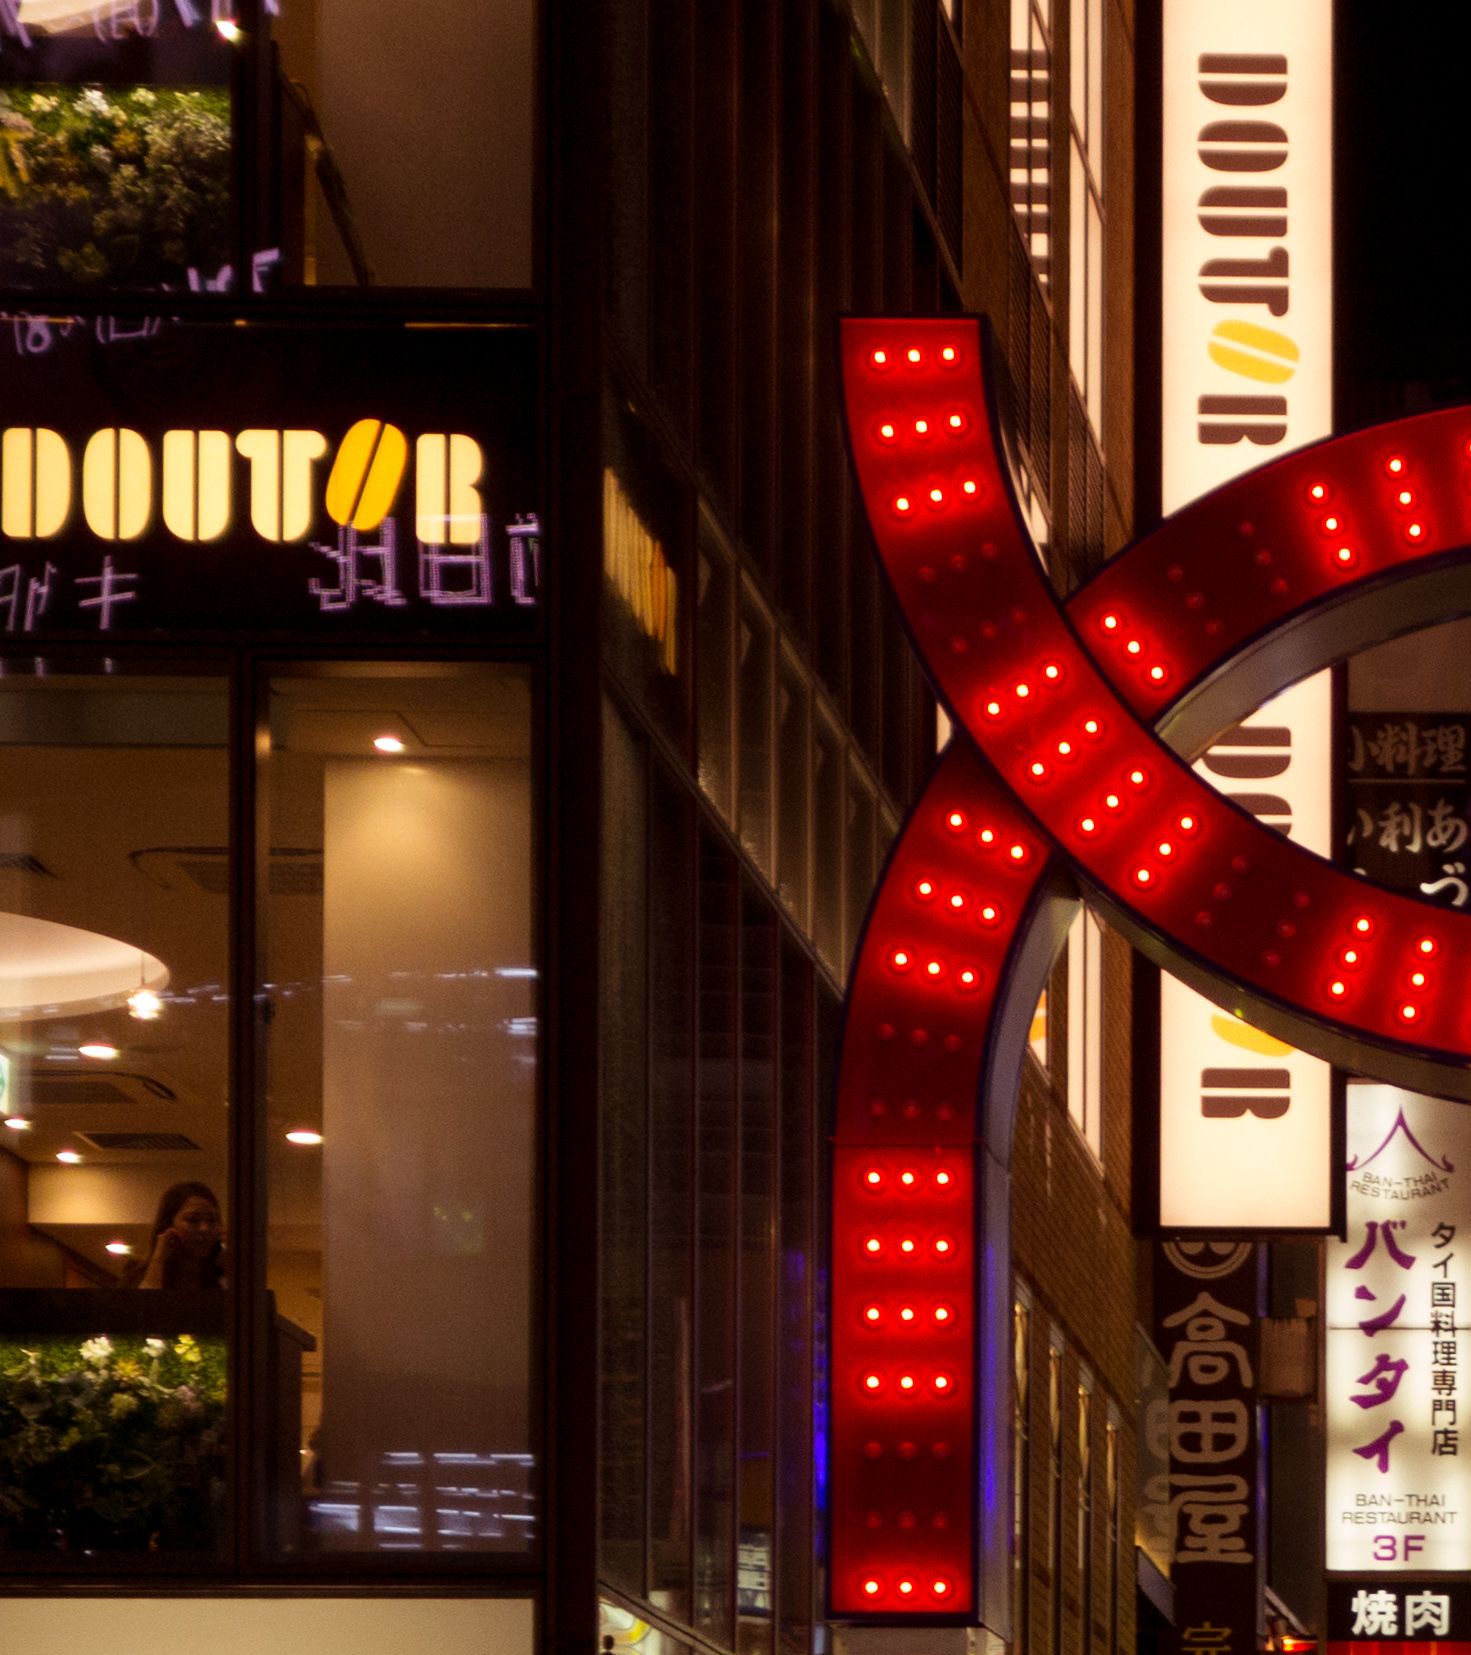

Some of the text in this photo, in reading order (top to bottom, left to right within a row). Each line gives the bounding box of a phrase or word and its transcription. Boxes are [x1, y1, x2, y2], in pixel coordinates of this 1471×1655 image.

[1197, 53, 1300, 445] DOUTOR
[2, 418, 484, 545] DOUTOR
[1350, 1177, 1452, 1201] RESTAURANT
[1345, 1220, 1416, 1474] バンタイ
[1430, 1222, 1459, 1456] タイ国料理専門店
[1162, 1291, 1254, 1563] 高田屋
[1341, 1511, 1458, 1526] RESTAURANT
[1373, 1534, 1426, 1562] 3F
[1350, 1589, 1451, 1636] 焼肉
